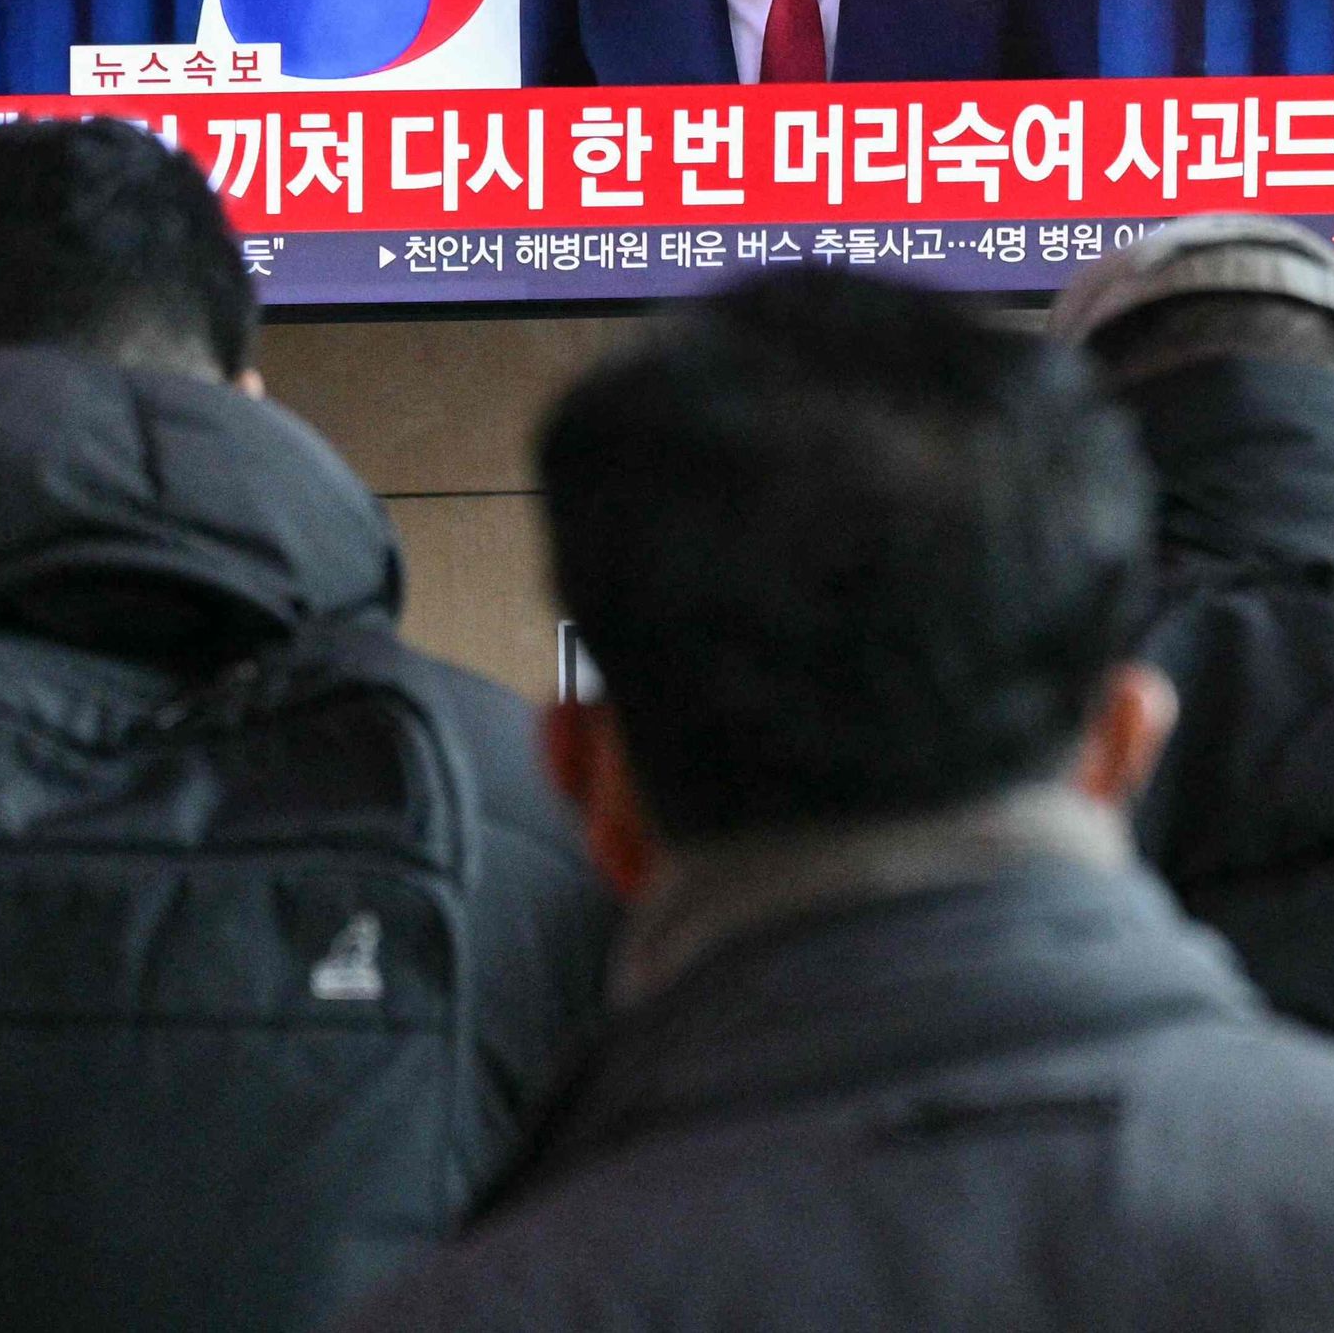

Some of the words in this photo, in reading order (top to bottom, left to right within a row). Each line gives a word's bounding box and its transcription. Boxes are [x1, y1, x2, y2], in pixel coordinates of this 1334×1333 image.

[92, 50, 262, 88] 뉴스속보
[207, 111, 364, 215] 끼쳐
[390, 108, 544, 212] 다시
[570, 105, 653, 207] 한
[673, 104, 745, 206] 번
[773, 100, 1084, 205] 머리숙여
[403, 234, 503, 273] 천안서
[514, 230, 648, 271] 해병대원
[660, 230, 727, 268] 태운
[737, 228, 803, 266] 버스
[1038, 222, 1103, 263] 병원
